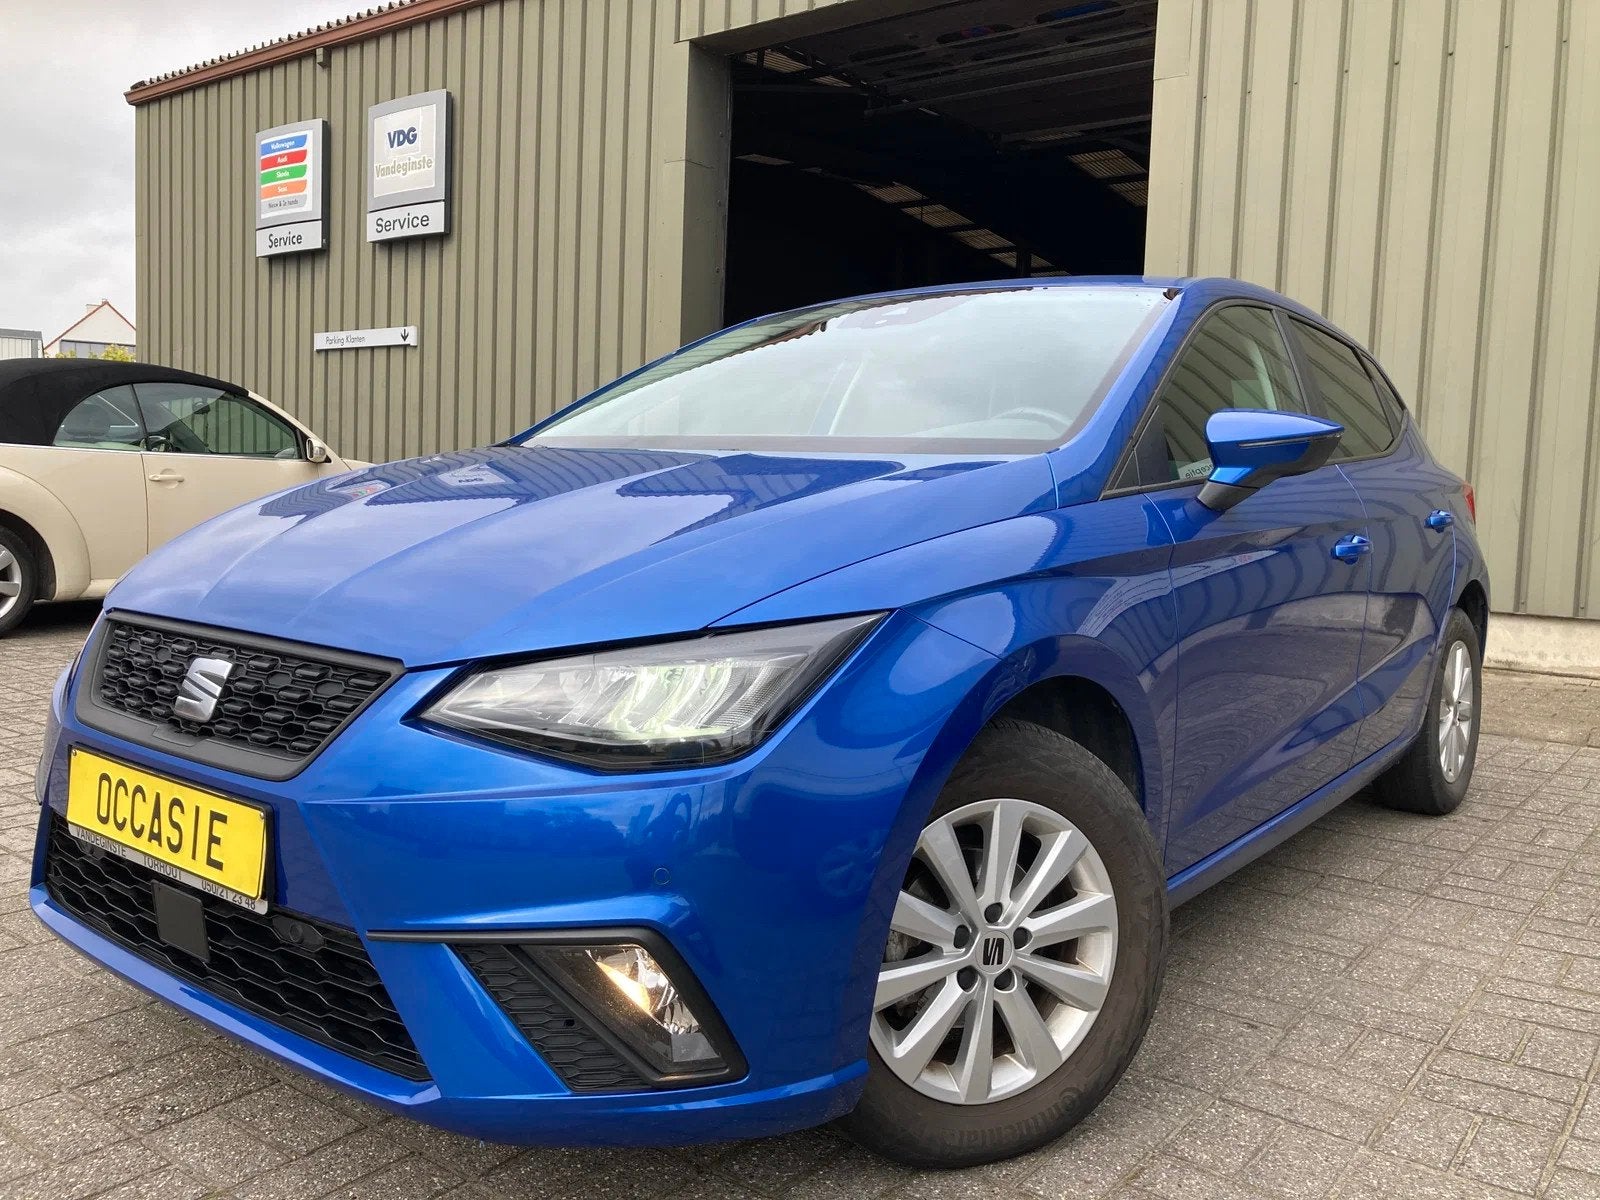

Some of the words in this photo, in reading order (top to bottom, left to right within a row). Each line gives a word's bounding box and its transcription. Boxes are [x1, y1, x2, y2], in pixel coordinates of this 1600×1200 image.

[387, 126, 418, 149] VDG
[276, 155, 288, 164] Audi
[375, 156, 433, 178] Vandeginste
[277, 186, 288, 194] Seat
[374, 212, 430, 234] Service
[268, 230, 303, 249] Service
[325, 335, 345, 346] Parking
[345, 334, 366, 344] Klanten
[96, 772, 228, 871] OCCASIE
[76, 826, 127, 858] VANDEGINSTE
[143, 855, 182, 881] TORHOUT
